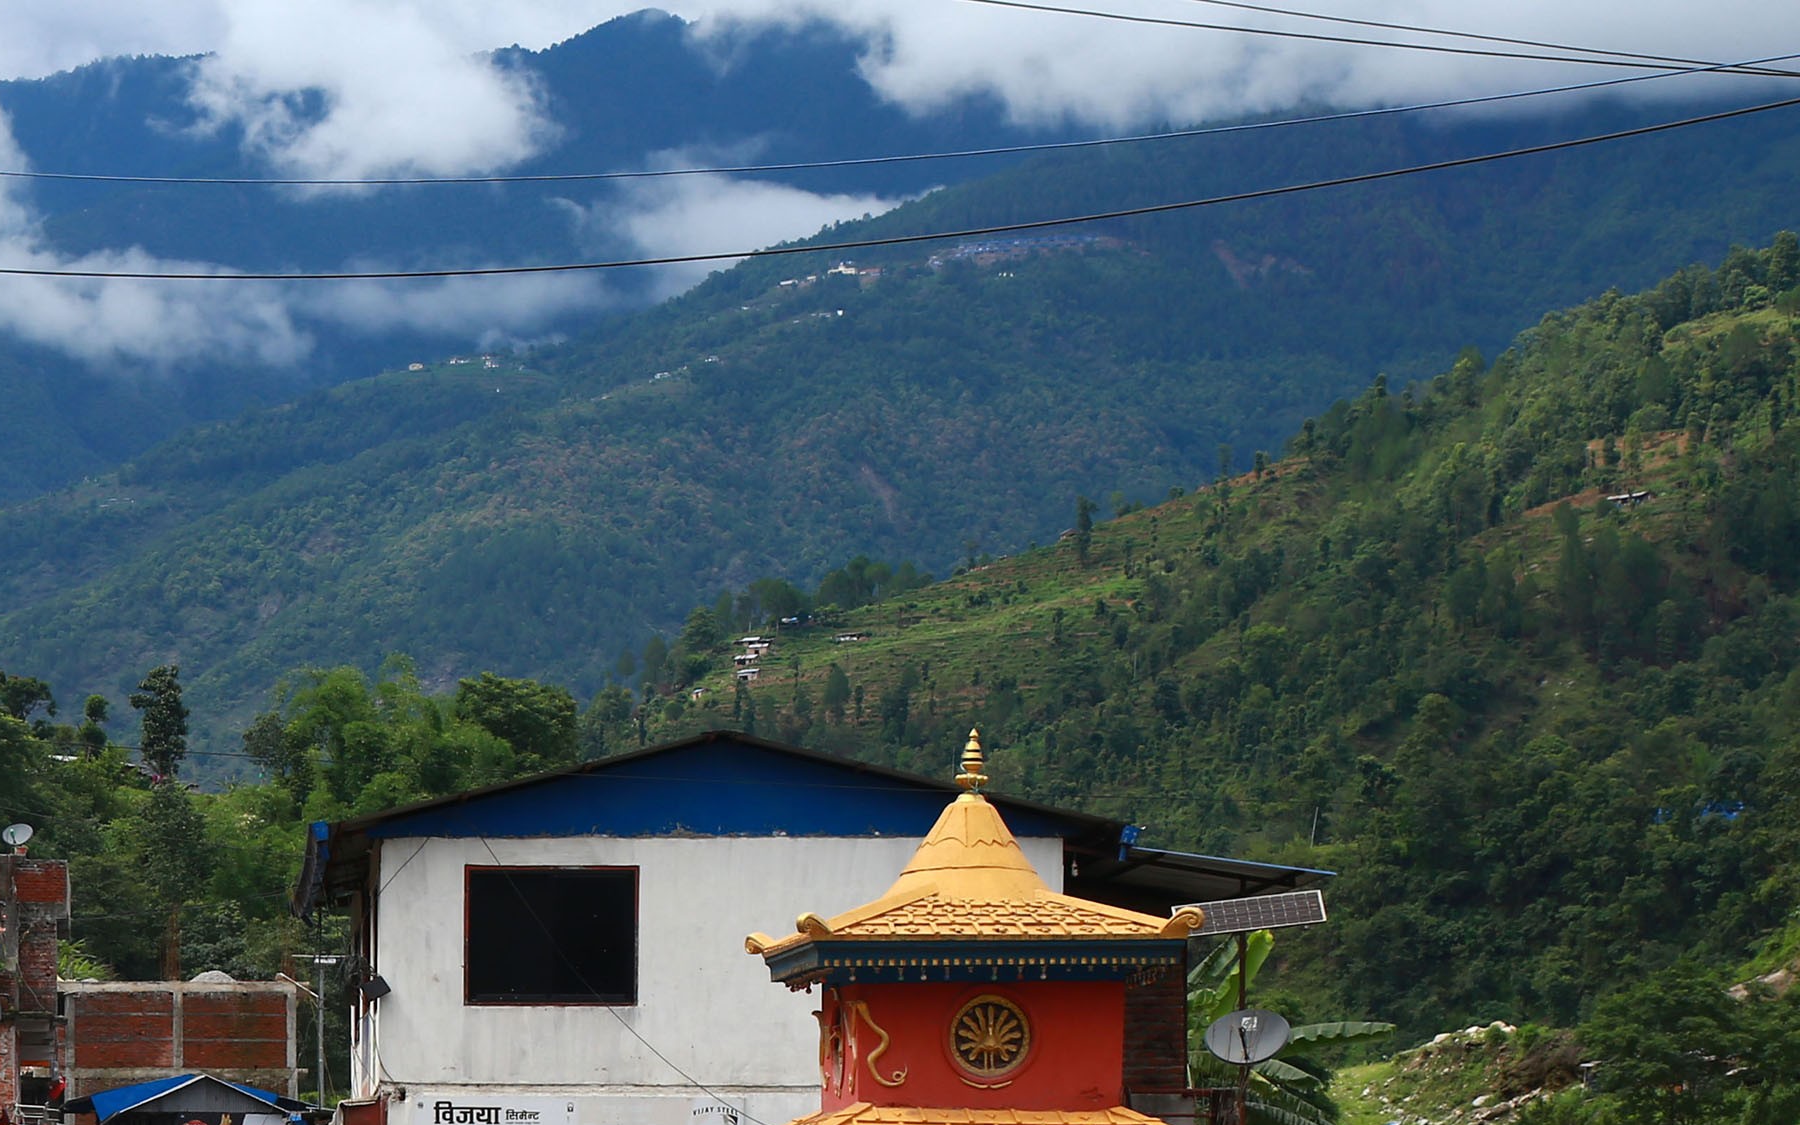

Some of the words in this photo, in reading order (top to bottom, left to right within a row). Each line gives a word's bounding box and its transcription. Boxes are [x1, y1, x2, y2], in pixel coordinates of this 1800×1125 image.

[433, 1101, 501, 1124] विजया
[505, 1109, 541, 1120] सिमेन्ट
[693, 1106, 714, 1116] VIJAY
[717, 1106, 739, 1116] STEEL
